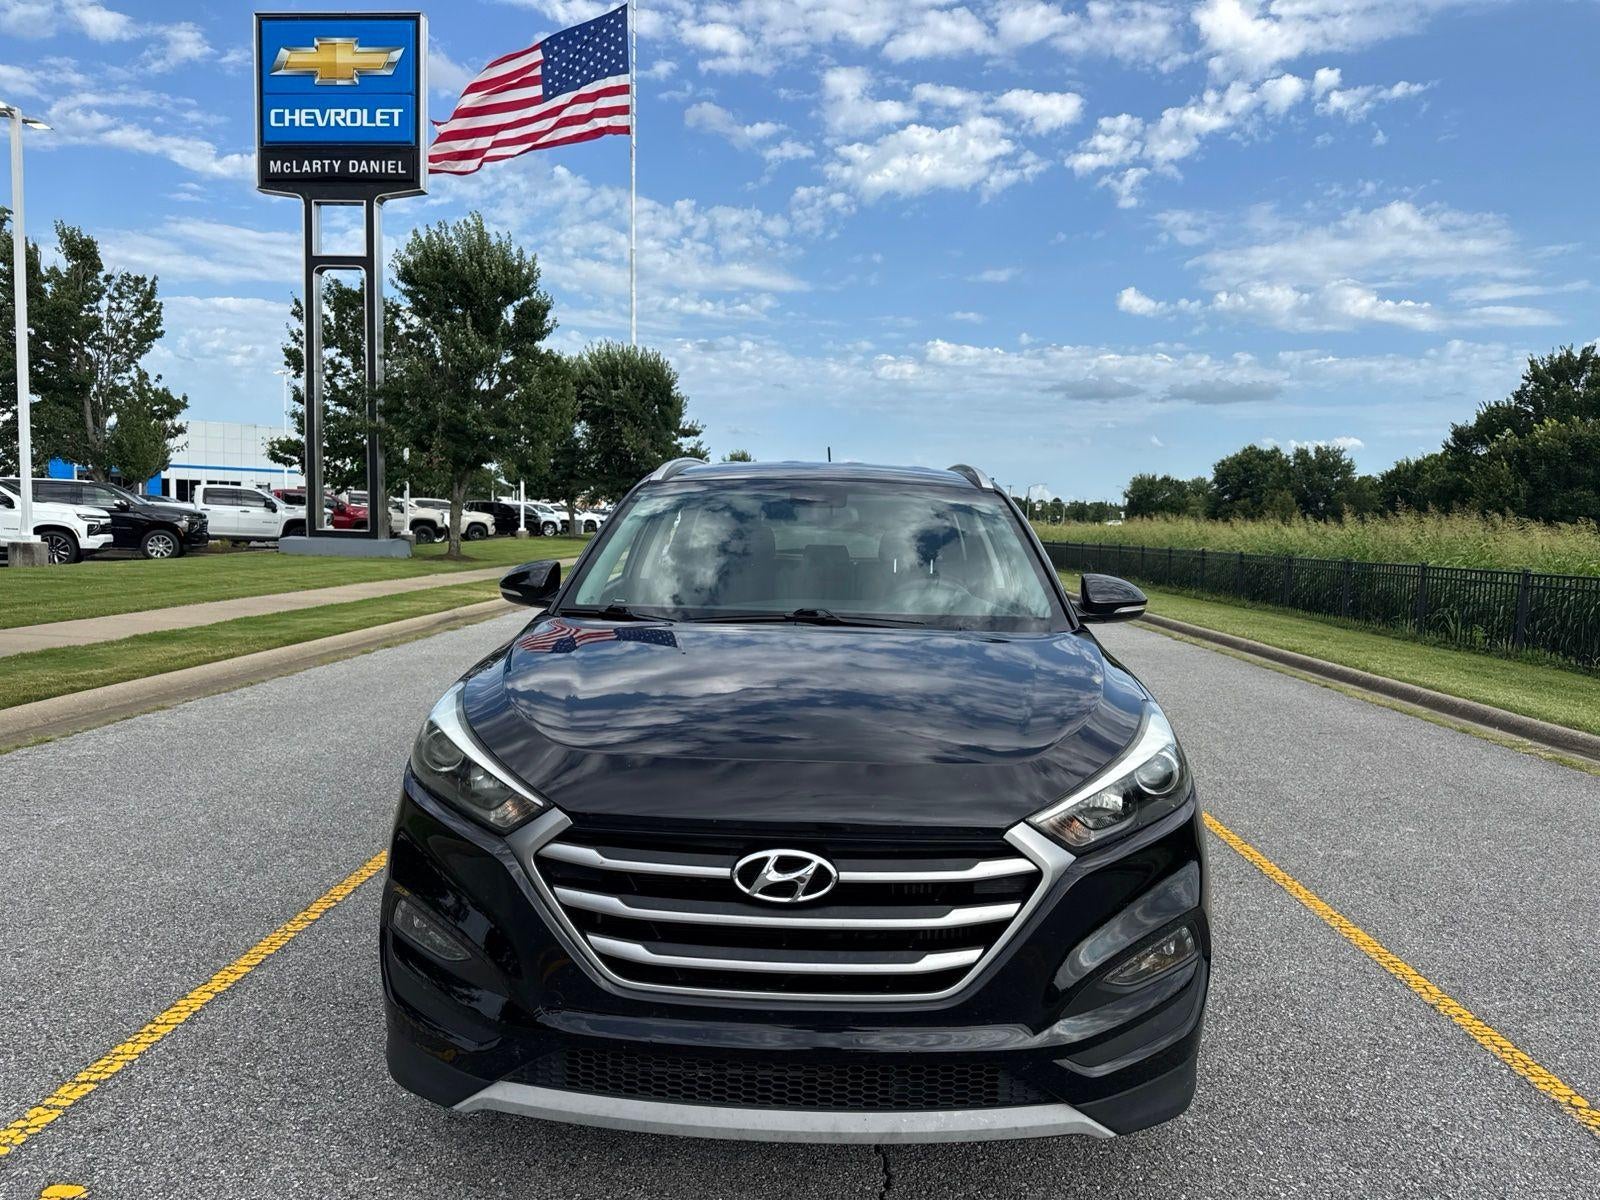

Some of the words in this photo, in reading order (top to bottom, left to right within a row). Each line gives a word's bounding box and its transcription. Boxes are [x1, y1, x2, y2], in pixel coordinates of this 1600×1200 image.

[270, 109, 403, 127] CHEVROLET
[269, 160, 342, 174] McLARTY
[349, 160, 406, 174] DANIEL
